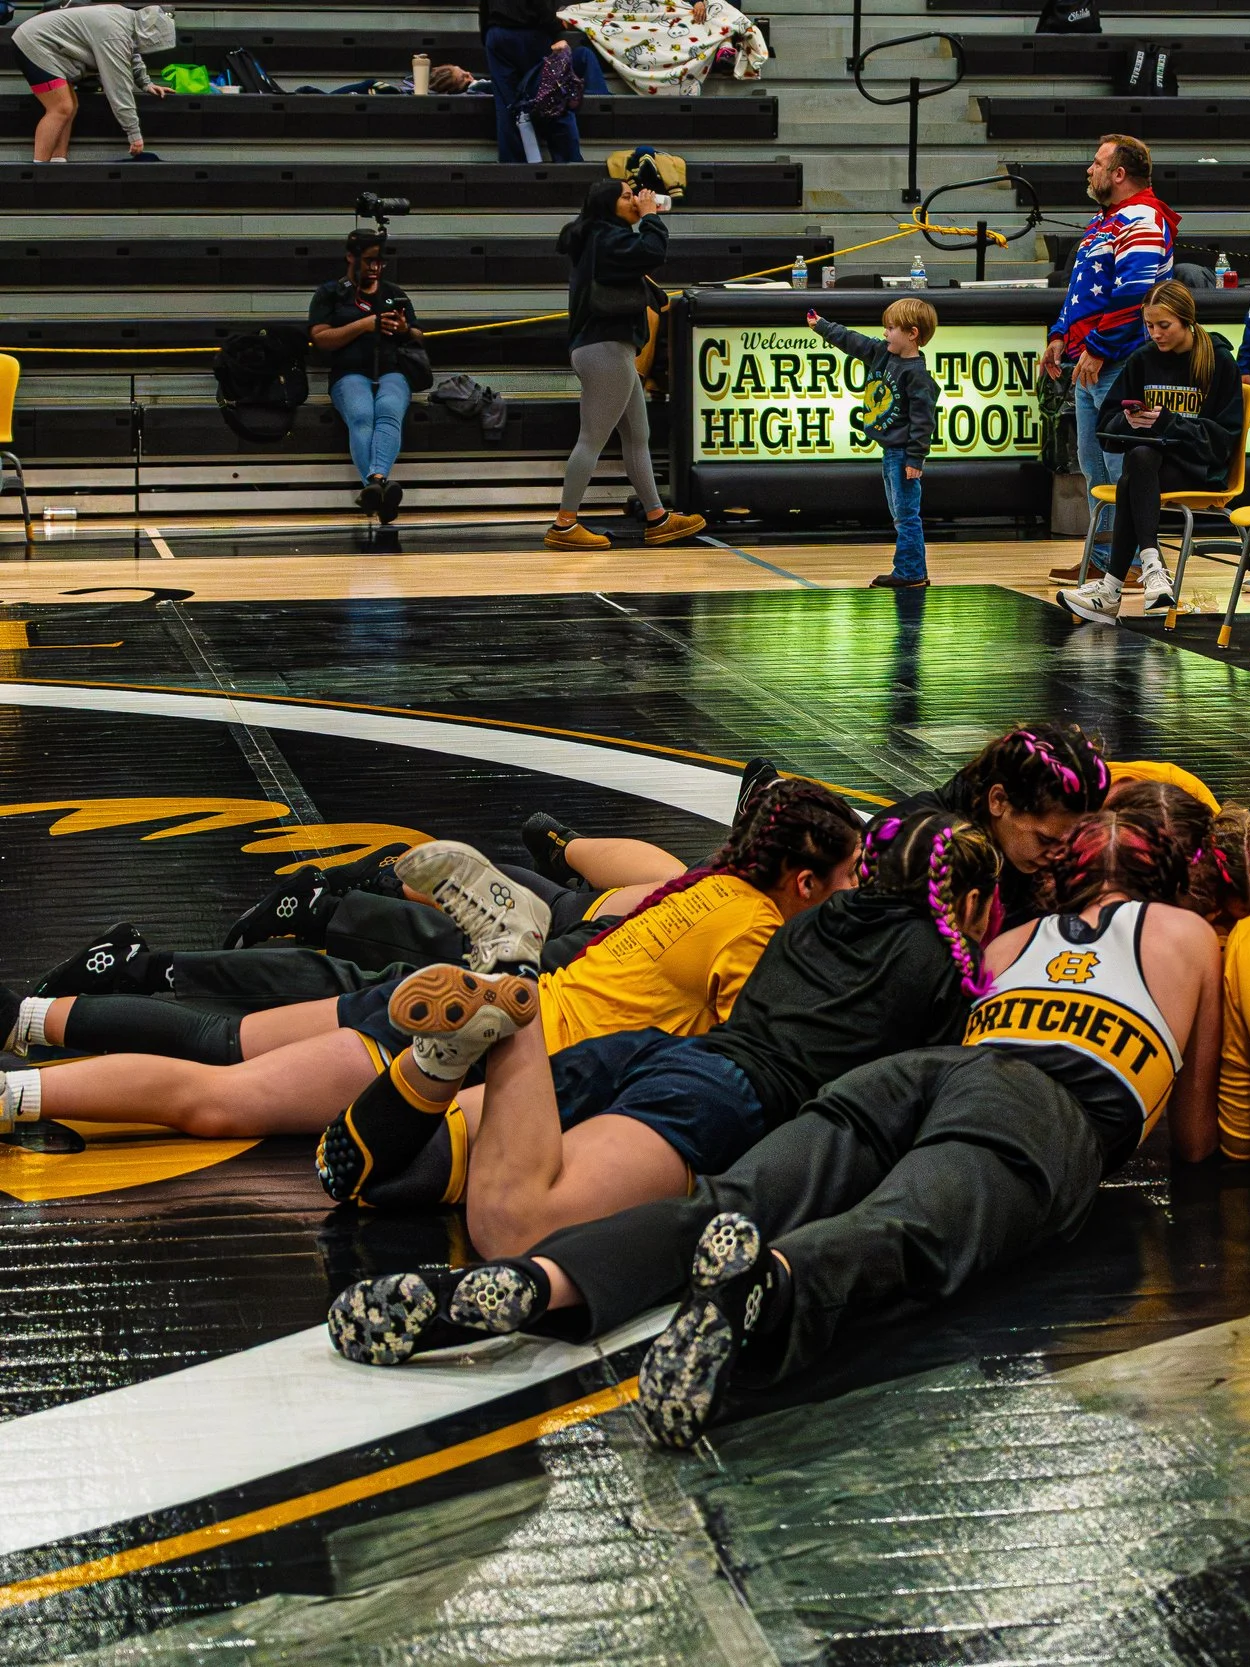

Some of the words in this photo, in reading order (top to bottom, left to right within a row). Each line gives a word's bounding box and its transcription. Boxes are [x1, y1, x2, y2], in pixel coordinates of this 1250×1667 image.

[741, 332, 817, 350] Welcome
[699, 338, 1037, 398] CARROTON
[701, 406, 833, 453] HIGH
[969, 997, 1158, 1075] PRITCHETT
